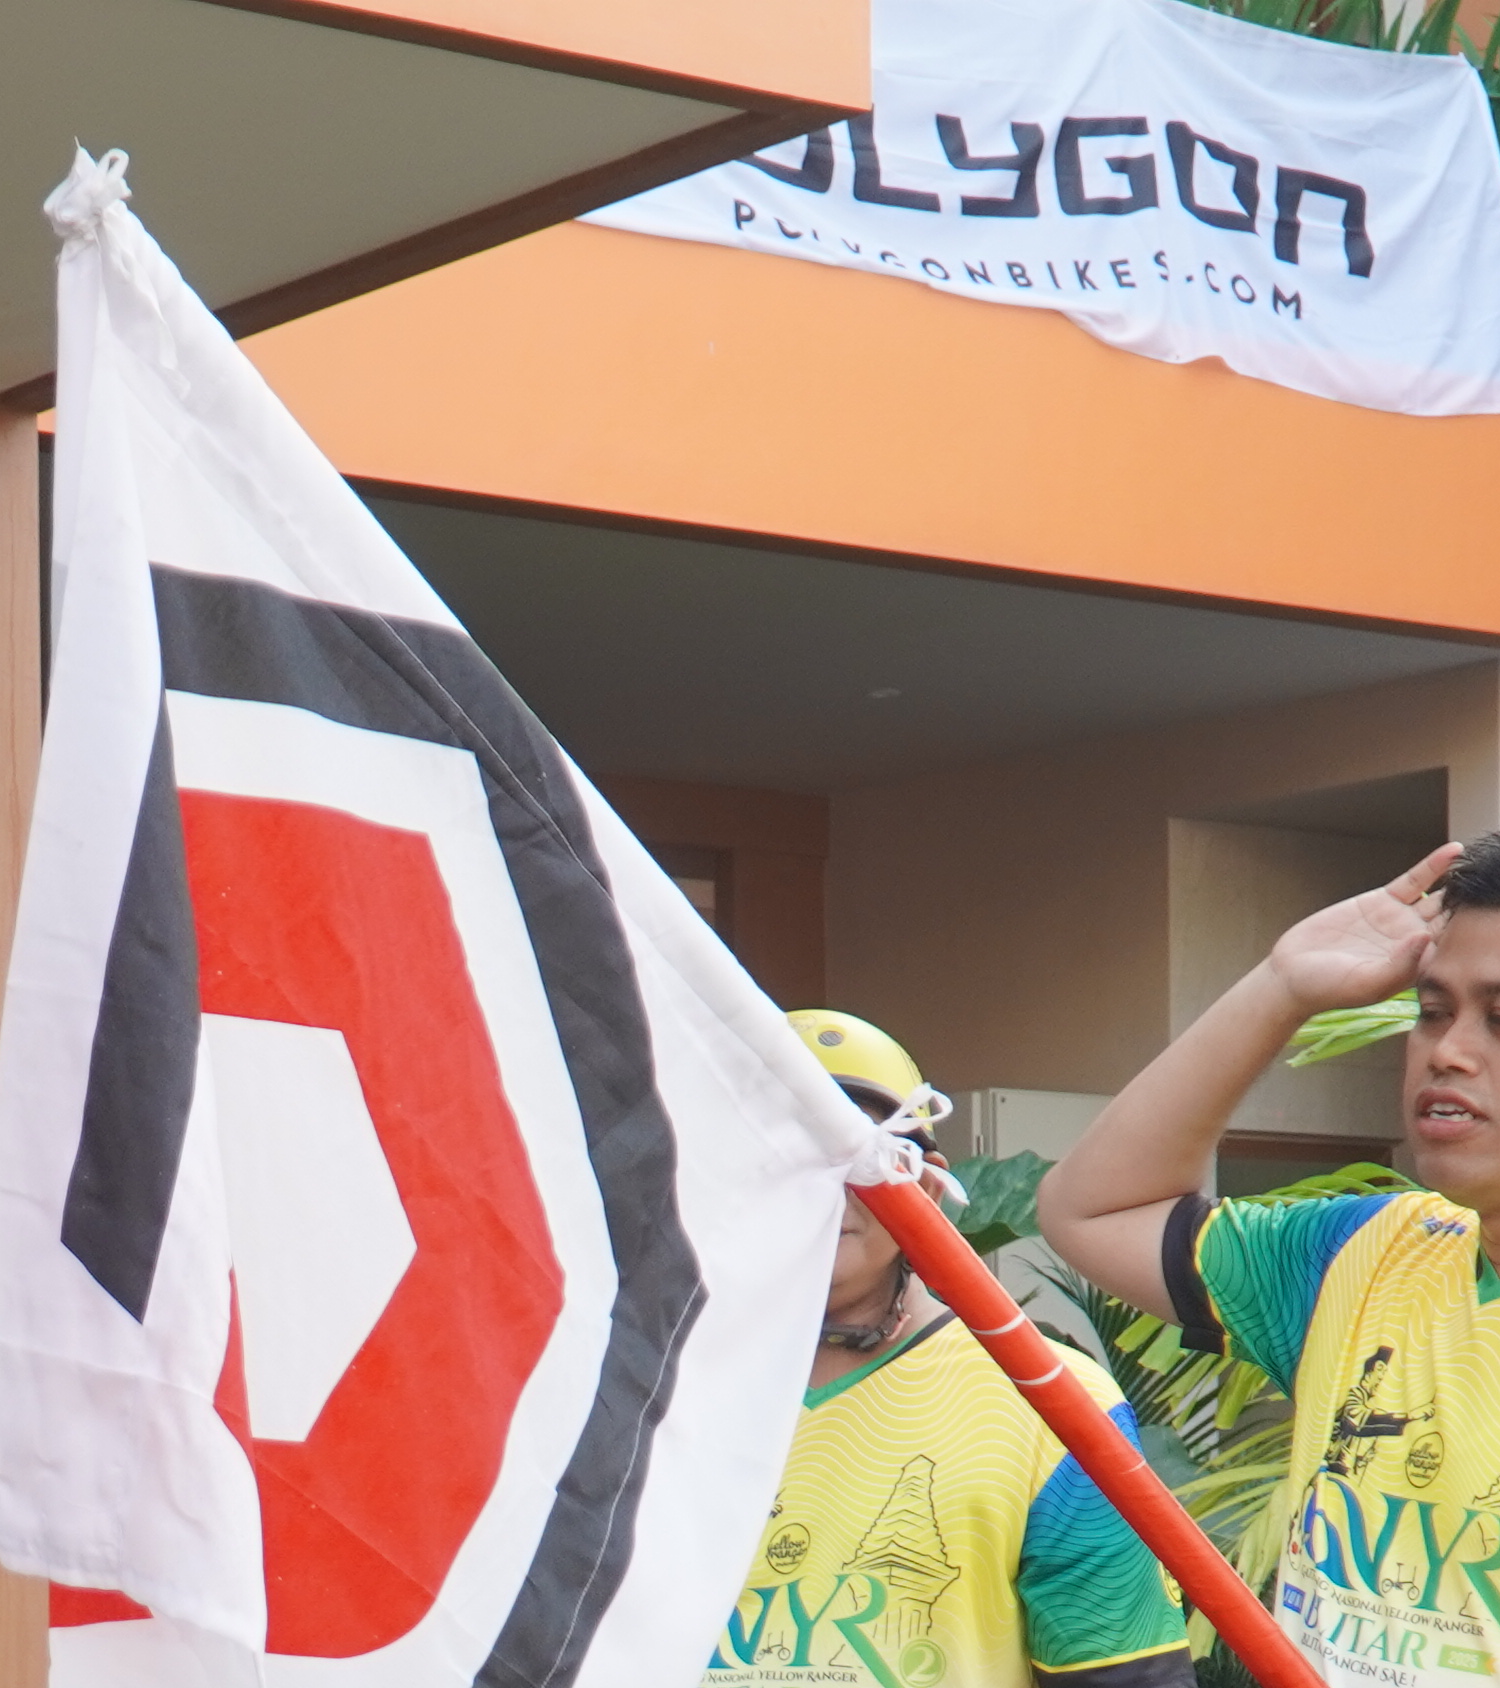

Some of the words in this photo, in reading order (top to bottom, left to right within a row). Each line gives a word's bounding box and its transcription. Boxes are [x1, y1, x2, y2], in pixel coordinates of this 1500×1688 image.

[733, 198, 1302, 320] PONBIKES.COM
[1384, 1605, 1432, 1626] YELLOW
[1433, 1616, 1485, 1638] RANGER
[1322, 1646, 1378, 1677] PANCEN
[1380, 1667, 1407, 1688] SAE
[1448, 1650, 1479, 1669] 2025
[707, 1670, 754, 1684] NASIONAL
[756, 1669, 804, 1682] YELLOW
[806, 1670, 858, 1684] RANGER
